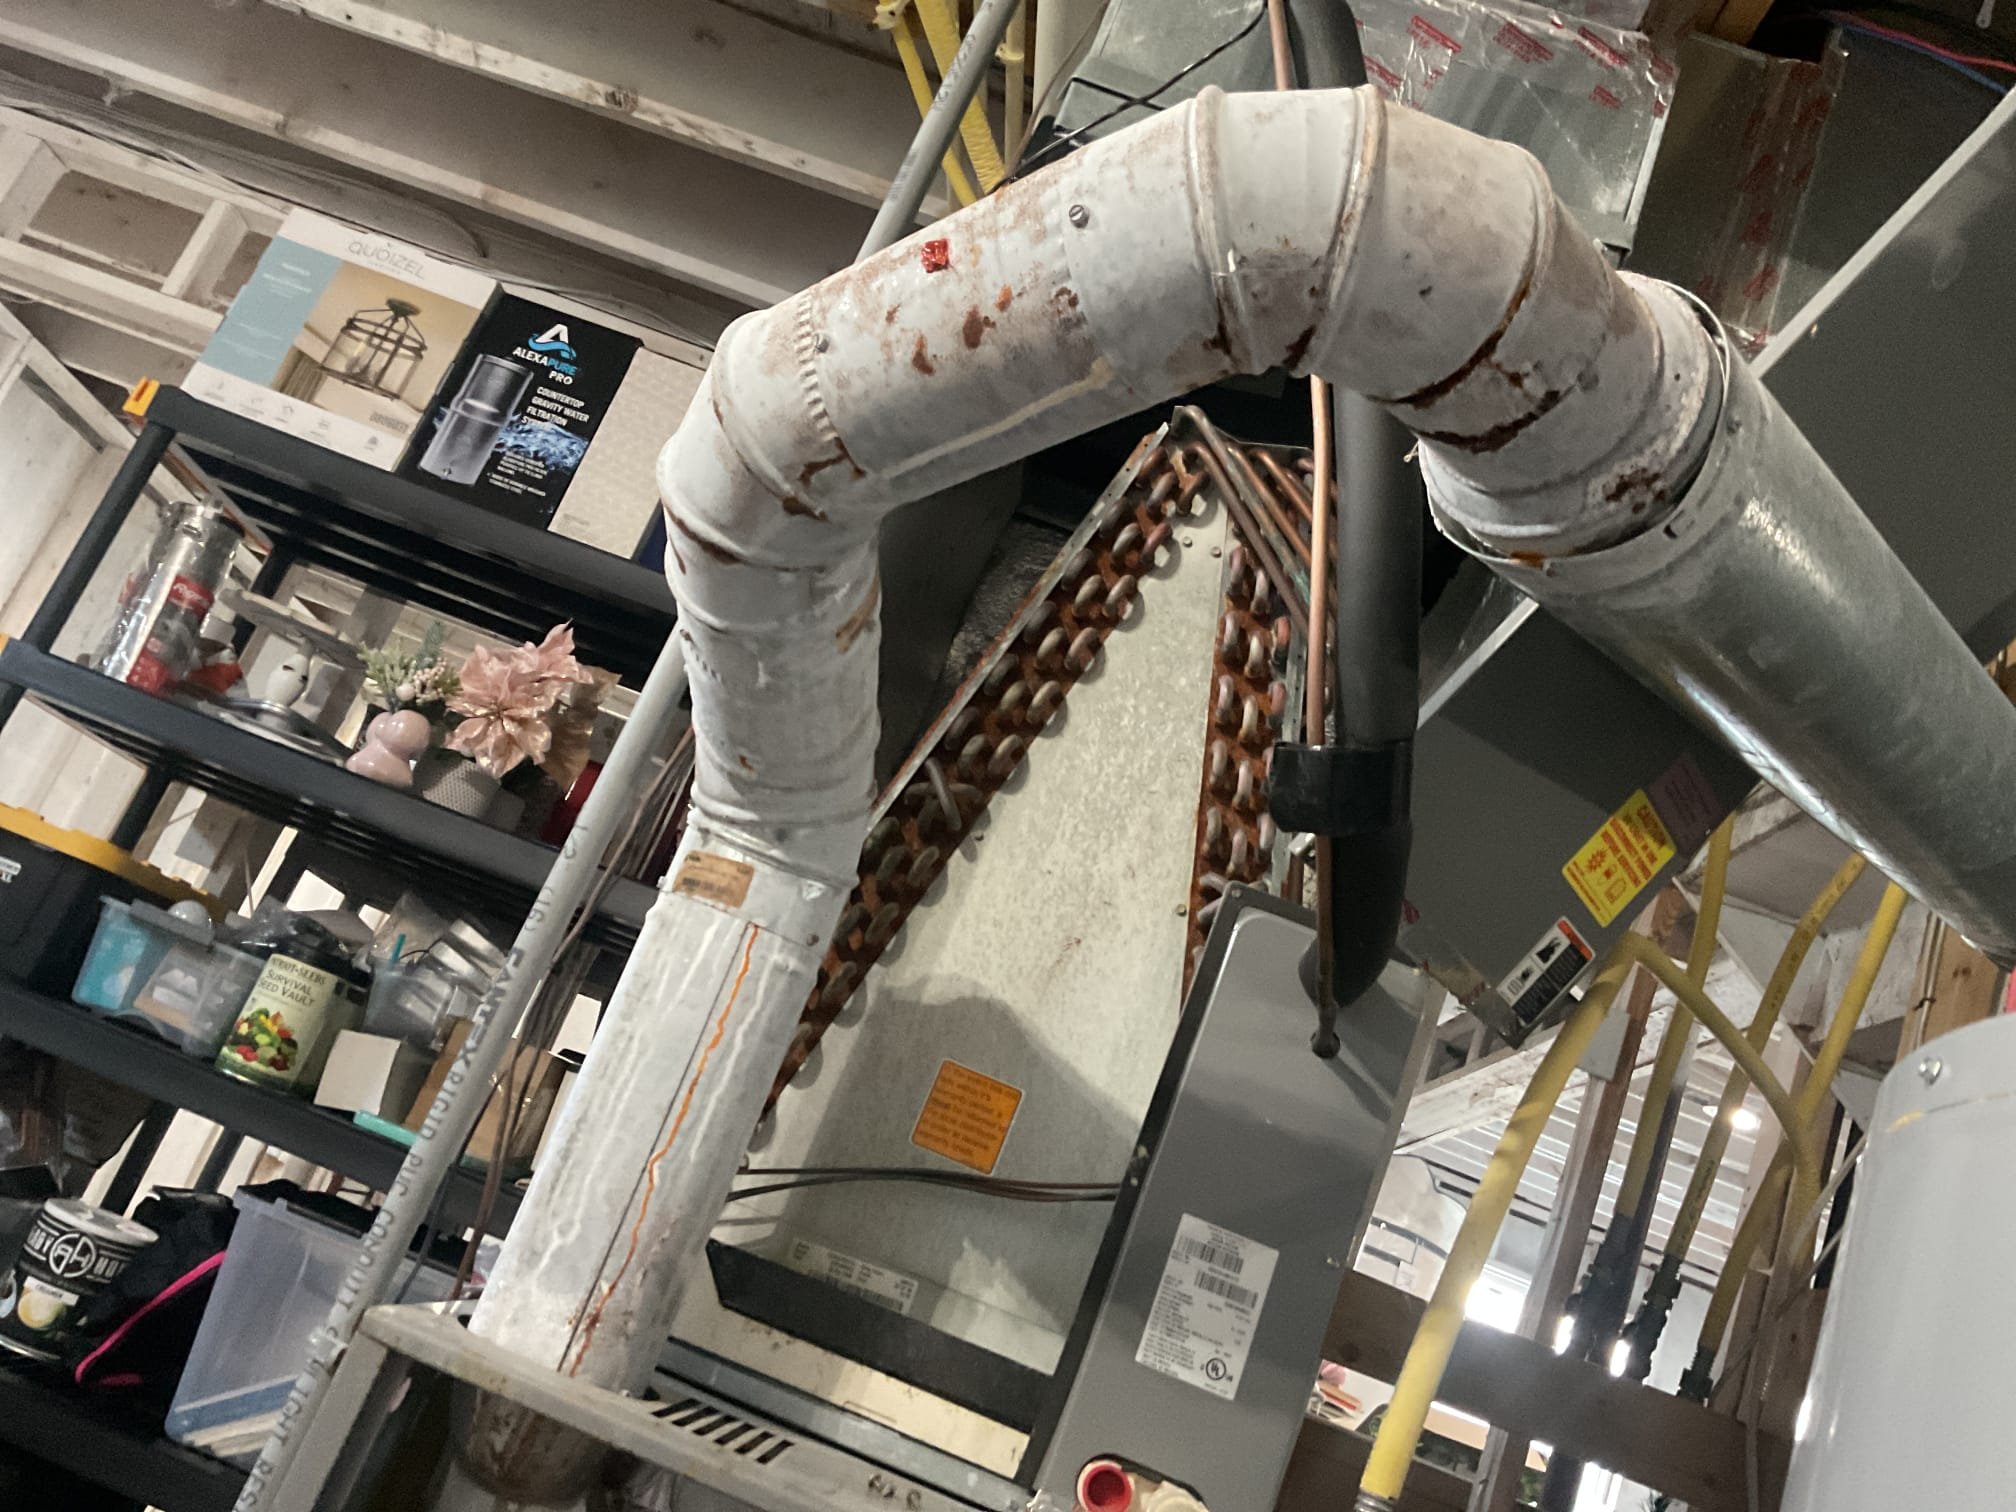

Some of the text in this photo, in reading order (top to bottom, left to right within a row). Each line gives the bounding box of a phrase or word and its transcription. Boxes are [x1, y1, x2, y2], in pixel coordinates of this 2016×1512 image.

[347, 241, 425, 280] QUOIZEL
[512, 346, 577, 375] ALEXAPURE
[548, 370, 574, 385] PRO
[531, 396, 590, 423] GRAVITY WATER
[536, 386, 585, 409] COUNTERTOP
[526, 405, 568, 427] FILTRATION
[266, 969, 312, 995] SURVIVAL
[281, 986, 316, 1006] VAULT
[420, 1071, 465, 1140] RIGID
[396, 1152, 423, 1197] PVC
[338, 1208, 394, 1312] CONDUIT
